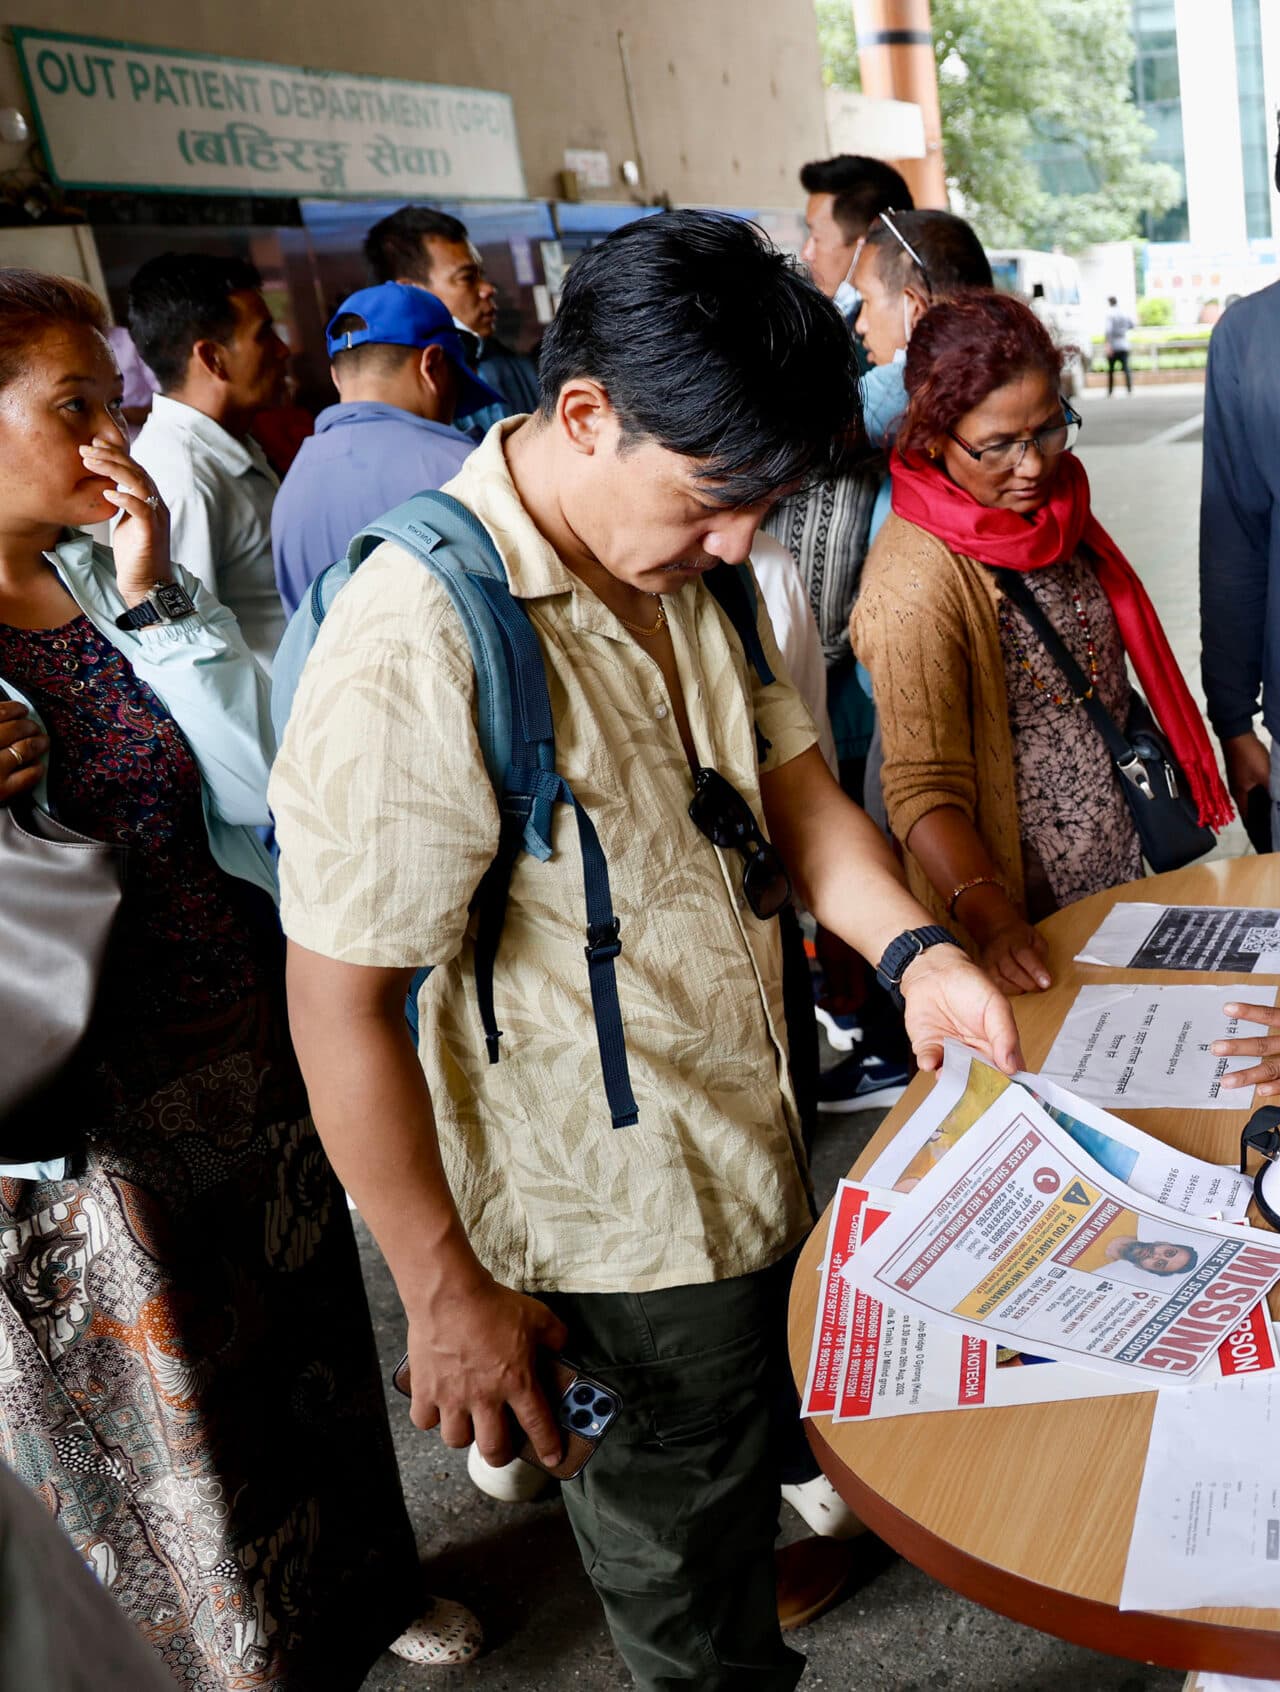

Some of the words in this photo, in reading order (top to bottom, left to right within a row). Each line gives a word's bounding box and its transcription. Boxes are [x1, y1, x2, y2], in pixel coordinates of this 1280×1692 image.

[36, 49, 116, 98] OUT
[129, 64, 263, 114] PATIENT
[271, 80, 442, 131] DEPARTMENT
[1005, 1138, 1034, 1168] PLEASE
[947, 1176, 972, 1202] THANK
[983, 1165, 1010, 1193] SHARE
[1004, 1179, 1018, 1193] +61
[961, 1188, 971, 1199] can
[977, 1188, 989, 1199] &
[1012, 1185, 1027, 1200] +91
[1017, 1193, 1035, 1211] +977
[933, 1198, 952, 1218] YOU!
[961, 1196, 983, 1217] HELP
[1014, 1199, 1044, 1231] CONTACT
[1043, 1203, 1060, 1220] EVERY
[1089, 1202, 1118, 1230] BHARAT
[943, 1213, 968, 1238] BRING
[1029, 1219, 1046, 1235] PIECE
[1064, 1213, 1076, 1223] IF
[846, 1214, 861, 1253] Contact
[1022, 1233, 1033, 1242] OF
[1050, 1221, 1069, 1238] YOU
[919, 1233, 949, 1264] BHARAT
[986, 1229, 1018, 1262] NUMBERS
[995, 1239, 1027, 1272] INFORMATION
[1033, 1236, 1054, 1255] HAVE
[1056, 1228, 1094, 1265] MANGWANI
[1210, 1242, 1239, 1263] HAVE
[831, 1252, 843, 1269] +91
[1019, 1254, 1037, 1270] ANY
[901, 1260, 926, 1285] HOME
[985, 1270, 999, 1283] CAN
[1194, 1264, 1217, 1280] YOU
[975, 1268, 1023, 1316] INFORMATION
[1038, 1278, 1056, 1294] DATE
[1172, 1281, 1201, 1303] SEEN
[824, 1271, 840, 1324] 9769758777
[1010, 1287, 1033, 1307] August
[1025, 1292, 1043, 1307] LAST
[1073, 1292, 1106, 1322] TRAVELLING
[1143, 1295, 1161, 1308] LAST
[866, 1297, 881, 1337] 20960669
[1011, 1305, 1030, 1321] SEEN
[1060, 1299, 1086, 1323] Foundation
[1124, 1308, 1148, 1328] KNOWN
[1155, 1302, 1181, 1322] THIS
[1061, 1320, 1078, 1335] WITH
[821, 1331, 832, 1346] +91
[900, 1337, 908, 1346] am
[914, 1332, 925, 1351] Bridge
[967, 1335, 980, 1350] SH
[1099, 1327, 1130, 1353] LOCATION
[1118, 1322, 1162, 1360] PERSON?
[1229, 1319, 1260, 1371] RSON
[850, 1343, 862, 1356] +91
[864, 1343, 875, 1356] +91
[965, 1352, 980, 1397] KOTECHA
[877, 1377, 887, 1395] group
